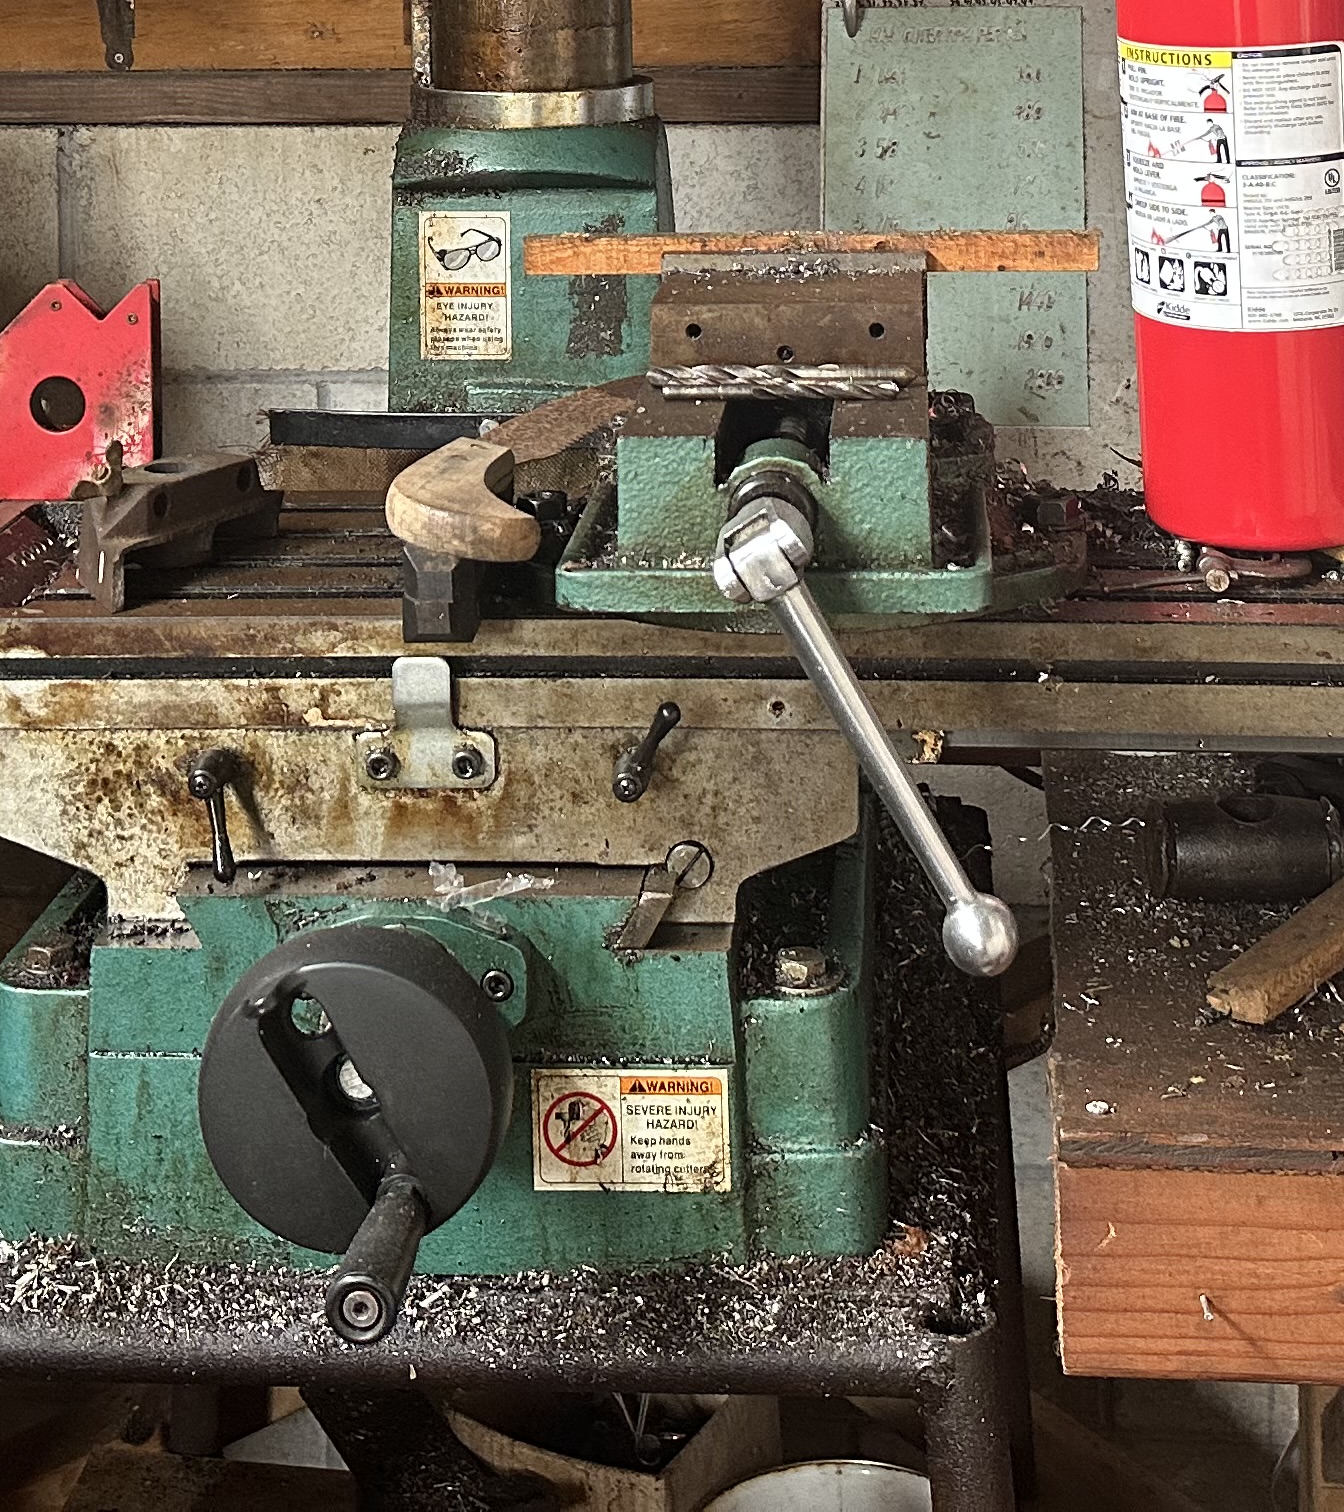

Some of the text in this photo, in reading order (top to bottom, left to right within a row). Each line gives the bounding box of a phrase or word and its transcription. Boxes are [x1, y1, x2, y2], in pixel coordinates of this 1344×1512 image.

[1126, 46, 1213, 67] INSTRUCTIONS
[444, 285, 505, 296] WARNING!
[436, 302, 494, 310] EYE INJURY
[1164, 301, 1192, 315] Kidde
[443, 313, 489, 322] HAZARD!
[645, 1080, 714, 1094] WARNING!
[626, 1104, 718, 1117] SEVERE INJURY
[646, 1119, 699, 1130] HAZARD!
[630, 1136, 691, 1147] Keep hands
[630, 1151, 657, 1160] away
[630, 1164, 671, 1176] rotating
